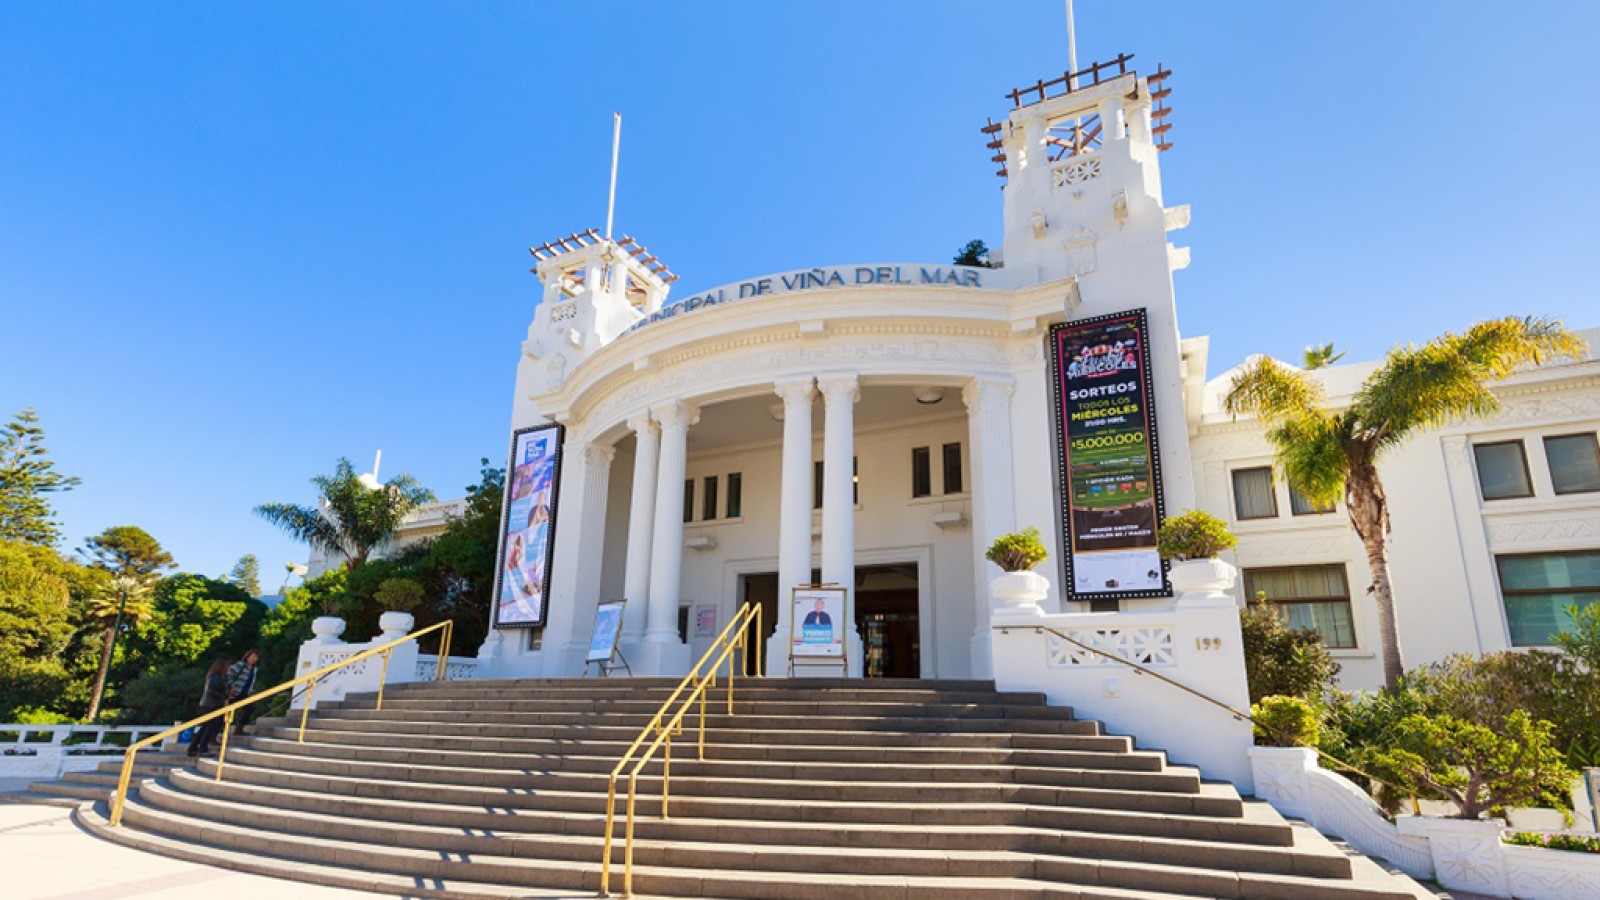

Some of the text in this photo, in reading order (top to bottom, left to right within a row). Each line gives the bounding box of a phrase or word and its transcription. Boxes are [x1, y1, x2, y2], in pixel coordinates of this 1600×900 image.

[738, 278, 774, 299] DE
[781, 267, 845, 290] VIÑA
[855, 266, 912, 285] DEL
[919, 267, 981, 288] MAR
[1070, 381, 1137, 401] SORTEOS
[1078, 396, 1131, 411] TODOS LOS
[1195, 636, 1222, 651] 199
